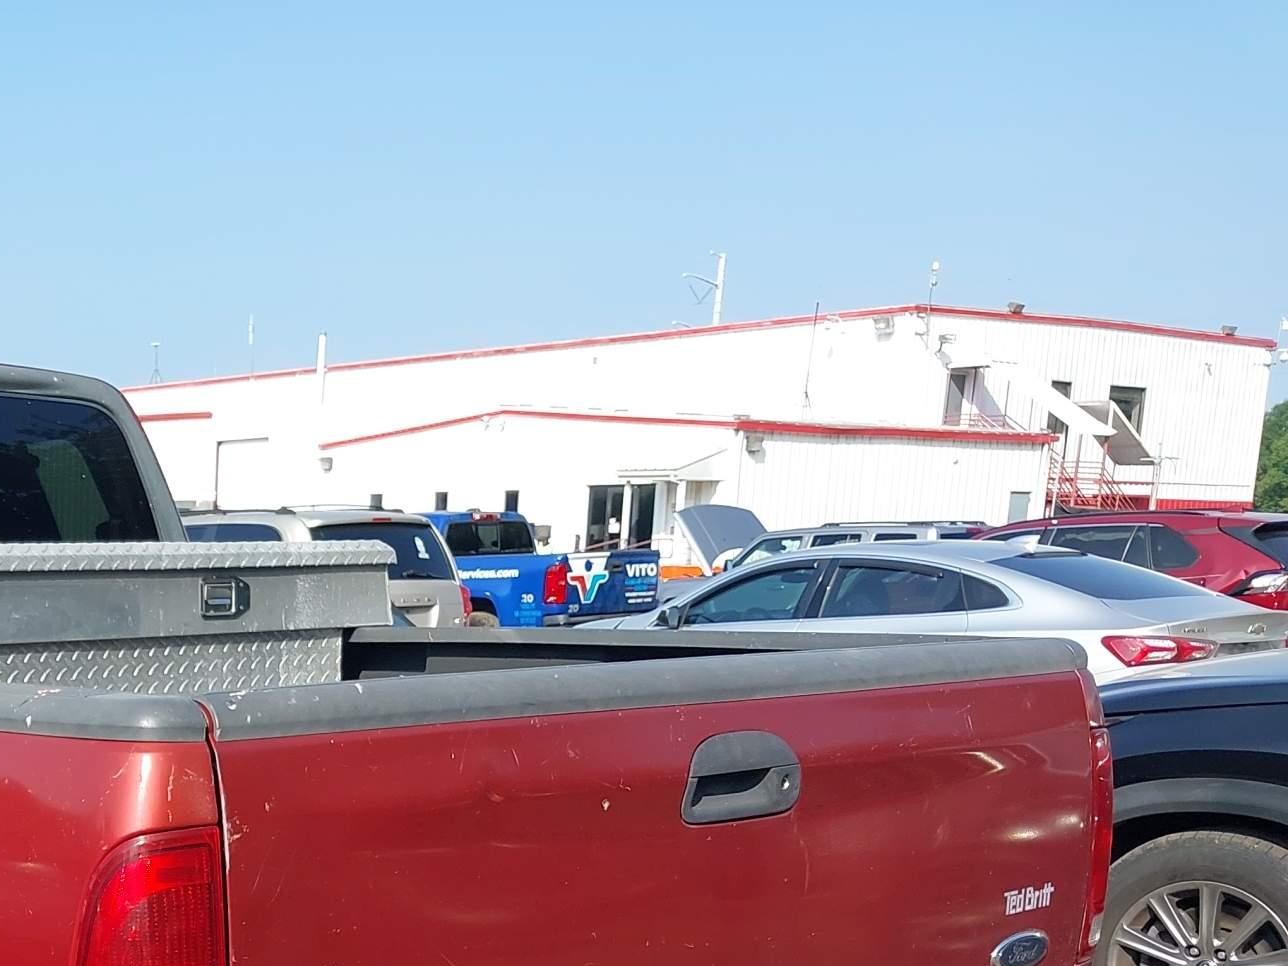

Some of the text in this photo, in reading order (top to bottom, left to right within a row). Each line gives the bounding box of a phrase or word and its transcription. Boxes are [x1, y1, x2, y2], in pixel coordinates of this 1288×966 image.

[625, 563, 657, 578] VITO
[1003, 882, 1055, 915] Ted Britt
[1008, 942, 1039, 964] Ford
